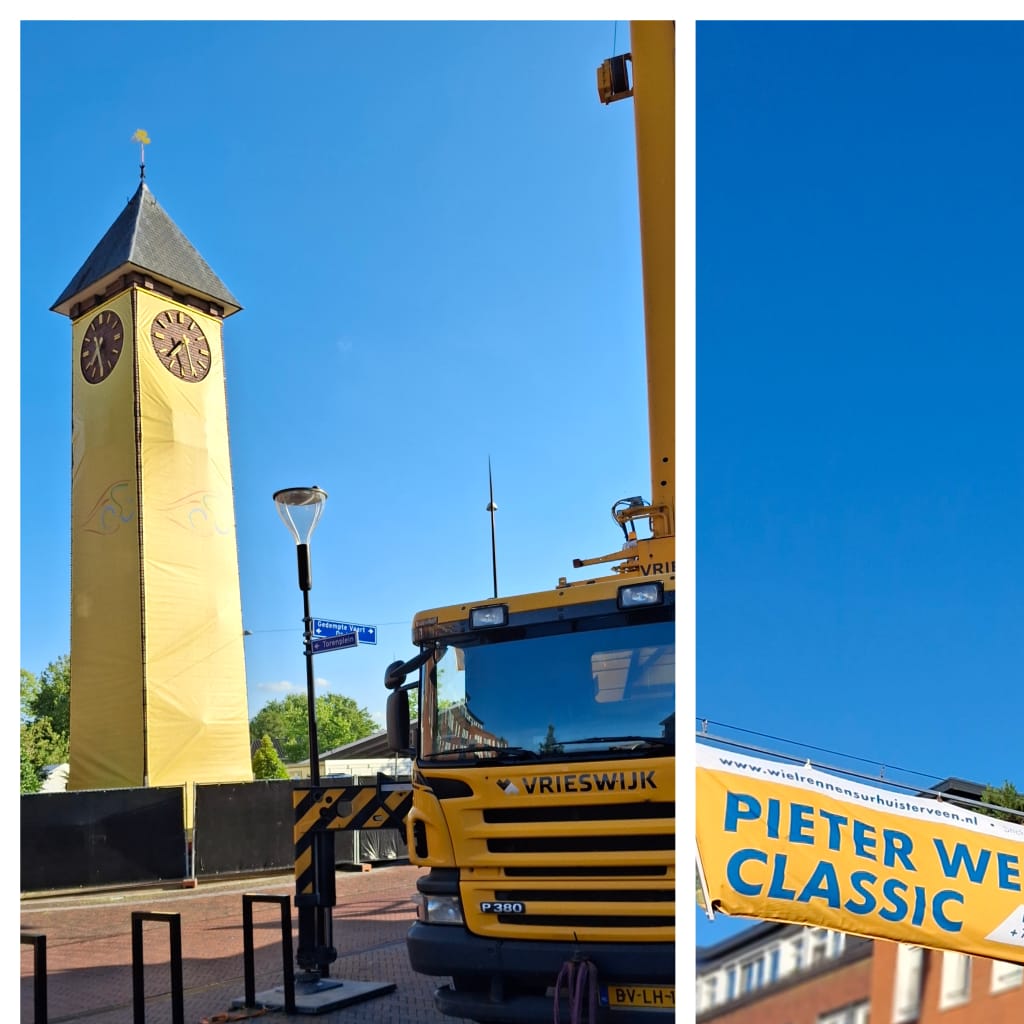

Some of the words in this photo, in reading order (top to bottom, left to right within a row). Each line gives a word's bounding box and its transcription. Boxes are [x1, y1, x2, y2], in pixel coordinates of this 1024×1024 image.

[318, 621, 347, 630] Gedempte
[323, 637, 354, 648] Torenplein
[522, 770, 657, 794] VRIESWIJK
[719, 757, 978, 826] www.wielrennensurhuisterveen.nl
[724, 790, 917, 871] PIETER
[726, 848, 964, 932] CLASSIC
[482, 903, 491, 912] P
[493, 903, 523, 912] 380
